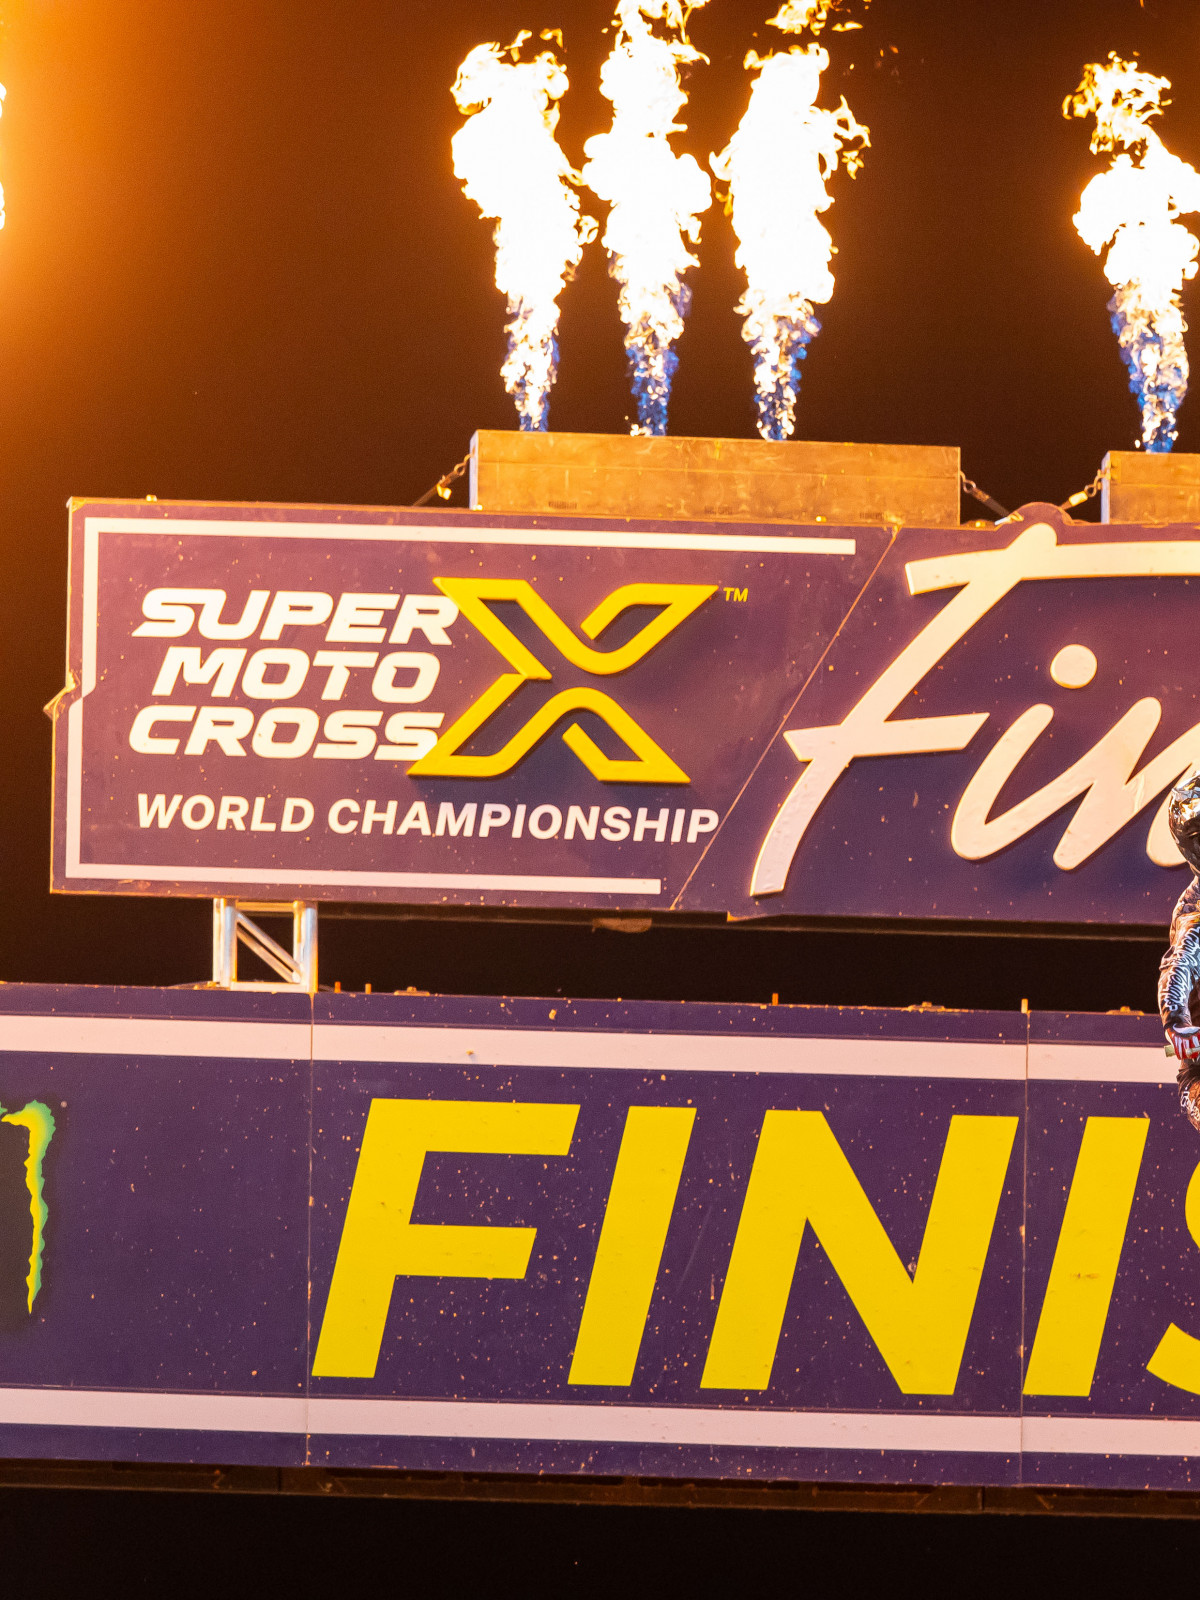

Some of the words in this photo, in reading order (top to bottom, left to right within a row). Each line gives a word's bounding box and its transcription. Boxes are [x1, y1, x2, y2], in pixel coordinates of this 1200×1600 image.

[131, 587, 459, 645] SUPER
[152, 646, 440, 704] MOTO
[128, 705, 445, 761] CROSS
[136, 793, 314, 832] WORLD
[327, 799, 719, 844] CHAMPIONSHIP
